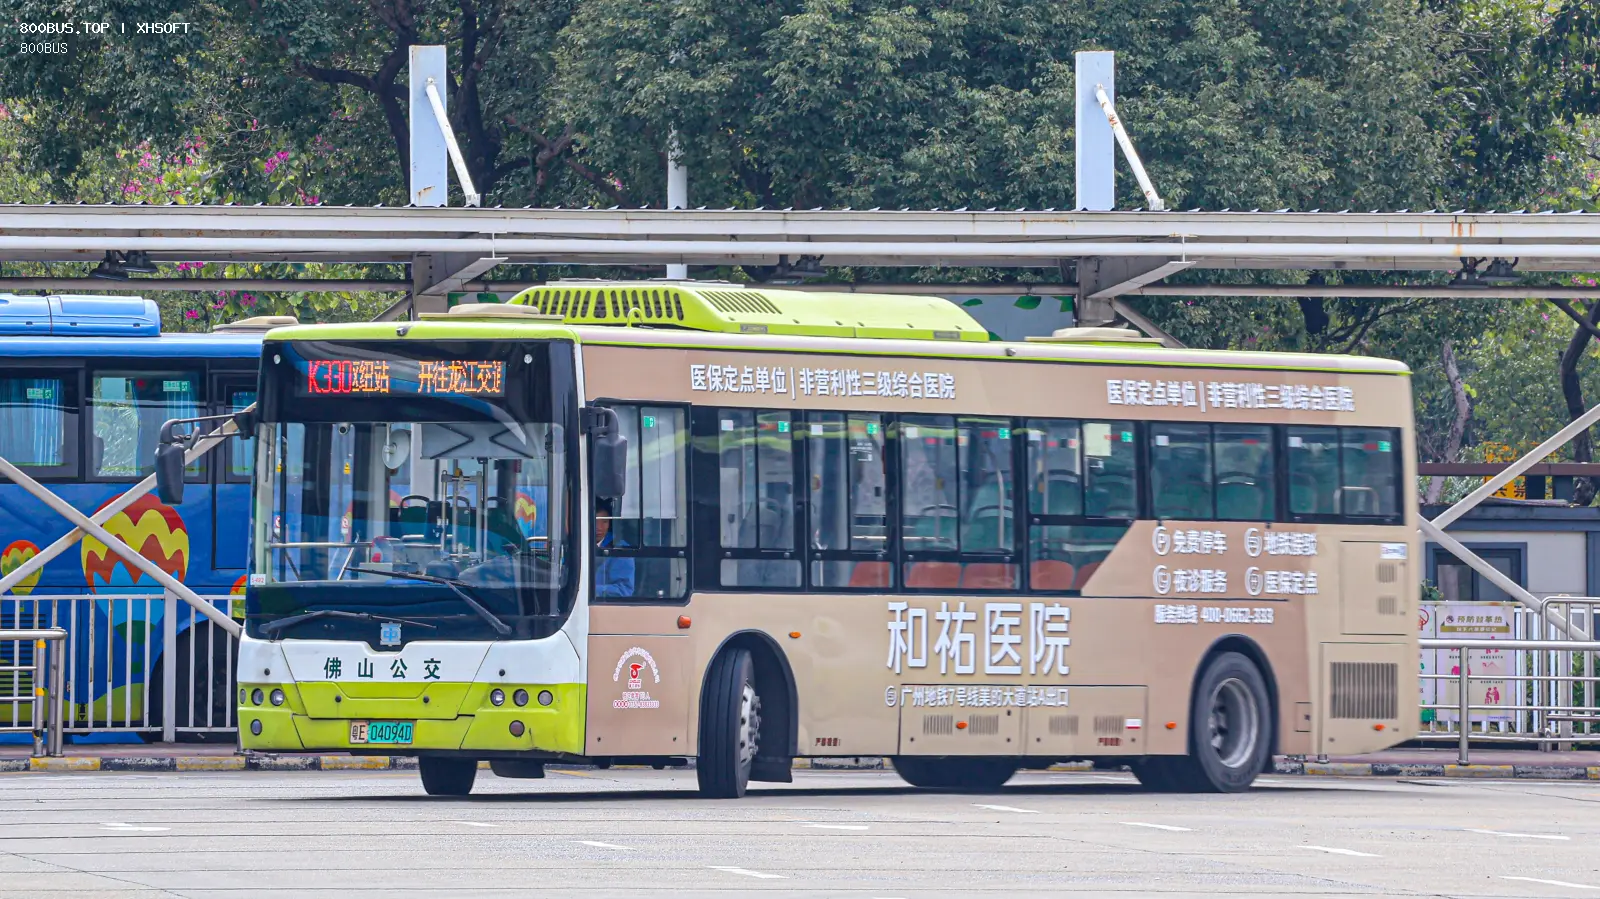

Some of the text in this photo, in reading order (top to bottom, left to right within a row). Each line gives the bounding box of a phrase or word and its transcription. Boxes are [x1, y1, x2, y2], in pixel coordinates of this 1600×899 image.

[1173, 530, 1227, 554] 免费停车
[1173, 569, 1227, 592] 夜诊服务
[1264, 571, 1319, 594] 医保定点
[886, 601, 1071, 675] 和祐医院
[323, 657, 441, 680] 佛山公交
